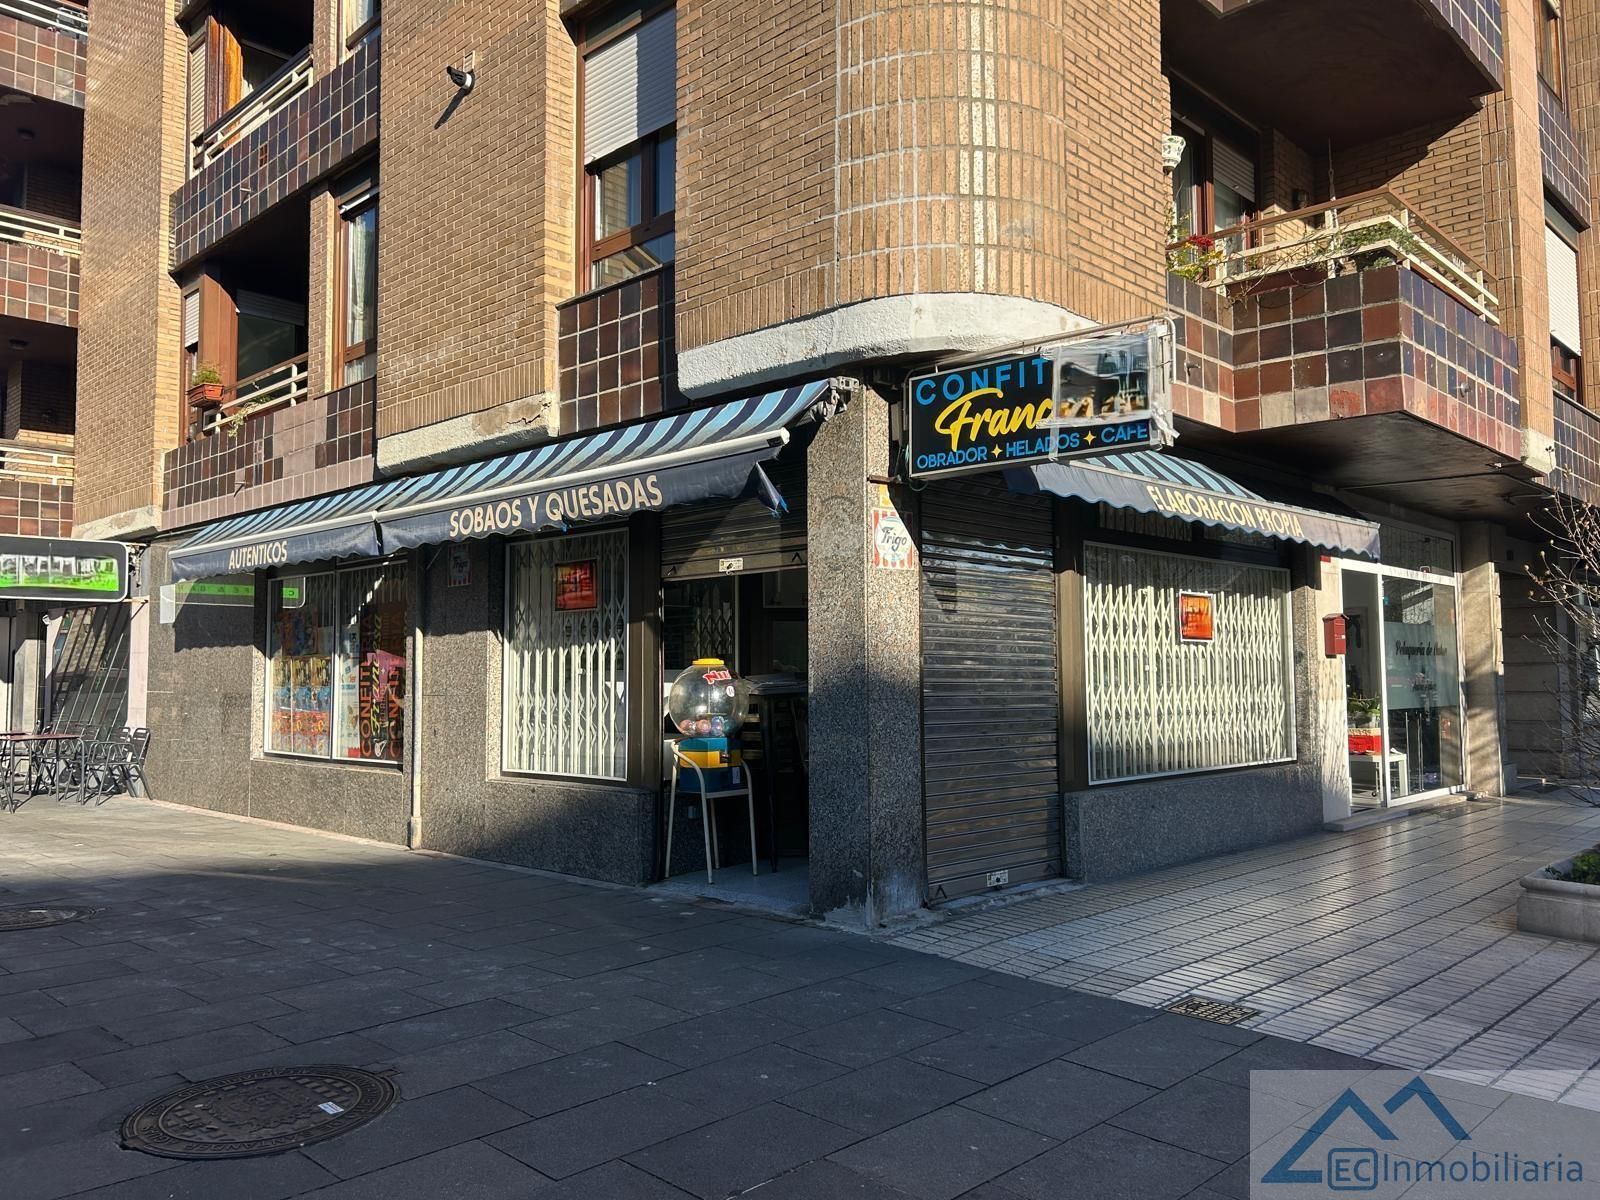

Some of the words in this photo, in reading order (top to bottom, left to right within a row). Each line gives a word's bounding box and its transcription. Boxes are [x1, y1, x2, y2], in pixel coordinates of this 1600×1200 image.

[915, 358, 1049, 406] CONFIT
[935, 387, 1054, 453] Franc
[917, 446, 988, 470] OBRADOR
[1006, 432, 1080, 457] HELADOS
[449, 500, 522, 537] SOBAOS
[527, 495, 539, 524] Y
[546, 475, 662, 521] QUESADAS
[1146, 485, 1256, 528] ELABORACION
[1255, 507, 1304, 537] PROPIA
[228, 540, 288, 570] AUTENTICOS
[881, 526, 907, 552] Frigo
